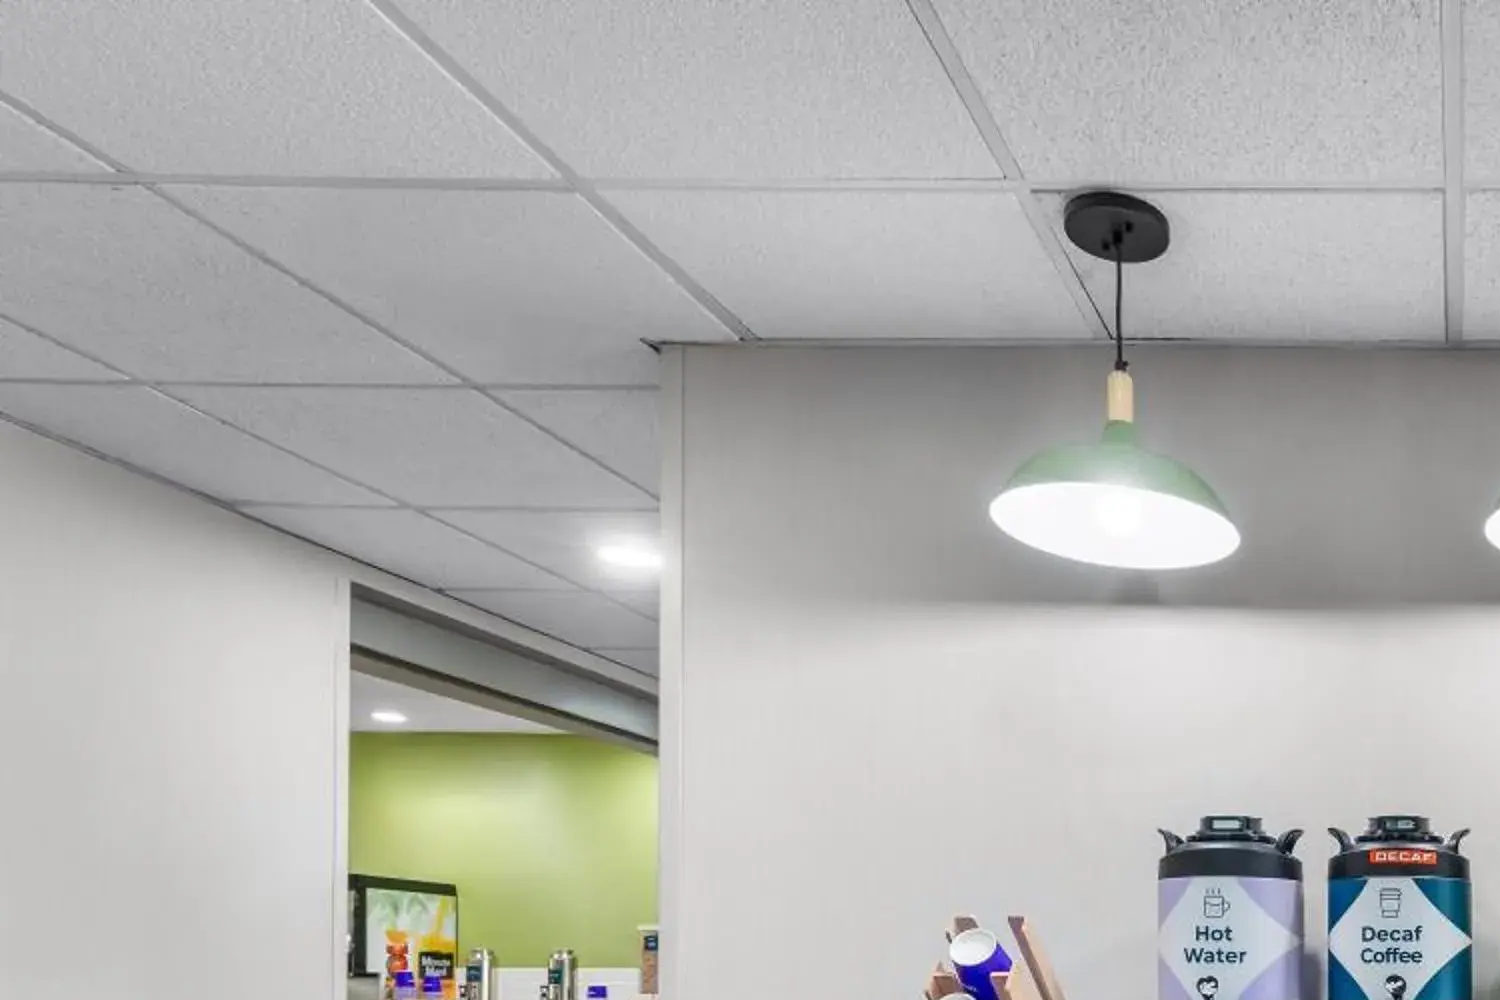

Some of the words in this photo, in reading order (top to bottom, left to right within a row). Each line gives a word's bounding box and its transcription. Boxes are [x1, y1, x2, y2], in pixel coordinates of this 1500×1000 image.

[1375, 851, 1436, 863] DECAF
[1195, 925, 1233, 941] Hot
[1361, 925, 1423, 942] Decaf
[1184, 947, 1247, 963] Water
[1361, 947, 1423, 963] Coffee
